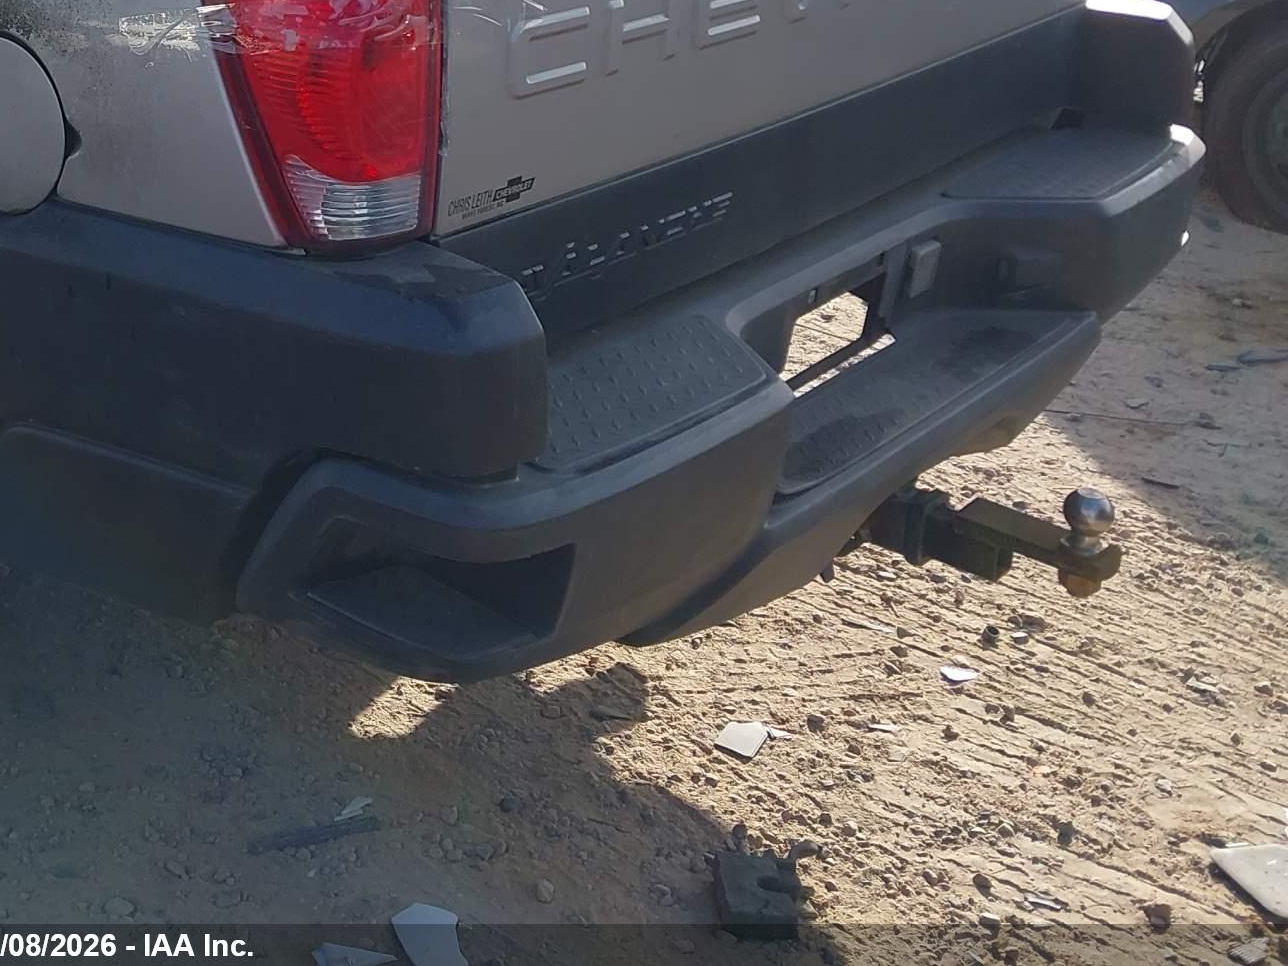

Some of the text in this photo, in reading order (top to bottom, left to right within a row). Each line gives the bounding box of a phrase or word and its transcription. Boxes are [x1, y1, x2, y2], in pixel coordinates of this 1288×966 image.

[447, 181, 533, 217] CHRIS LEITH CHEVROLET
